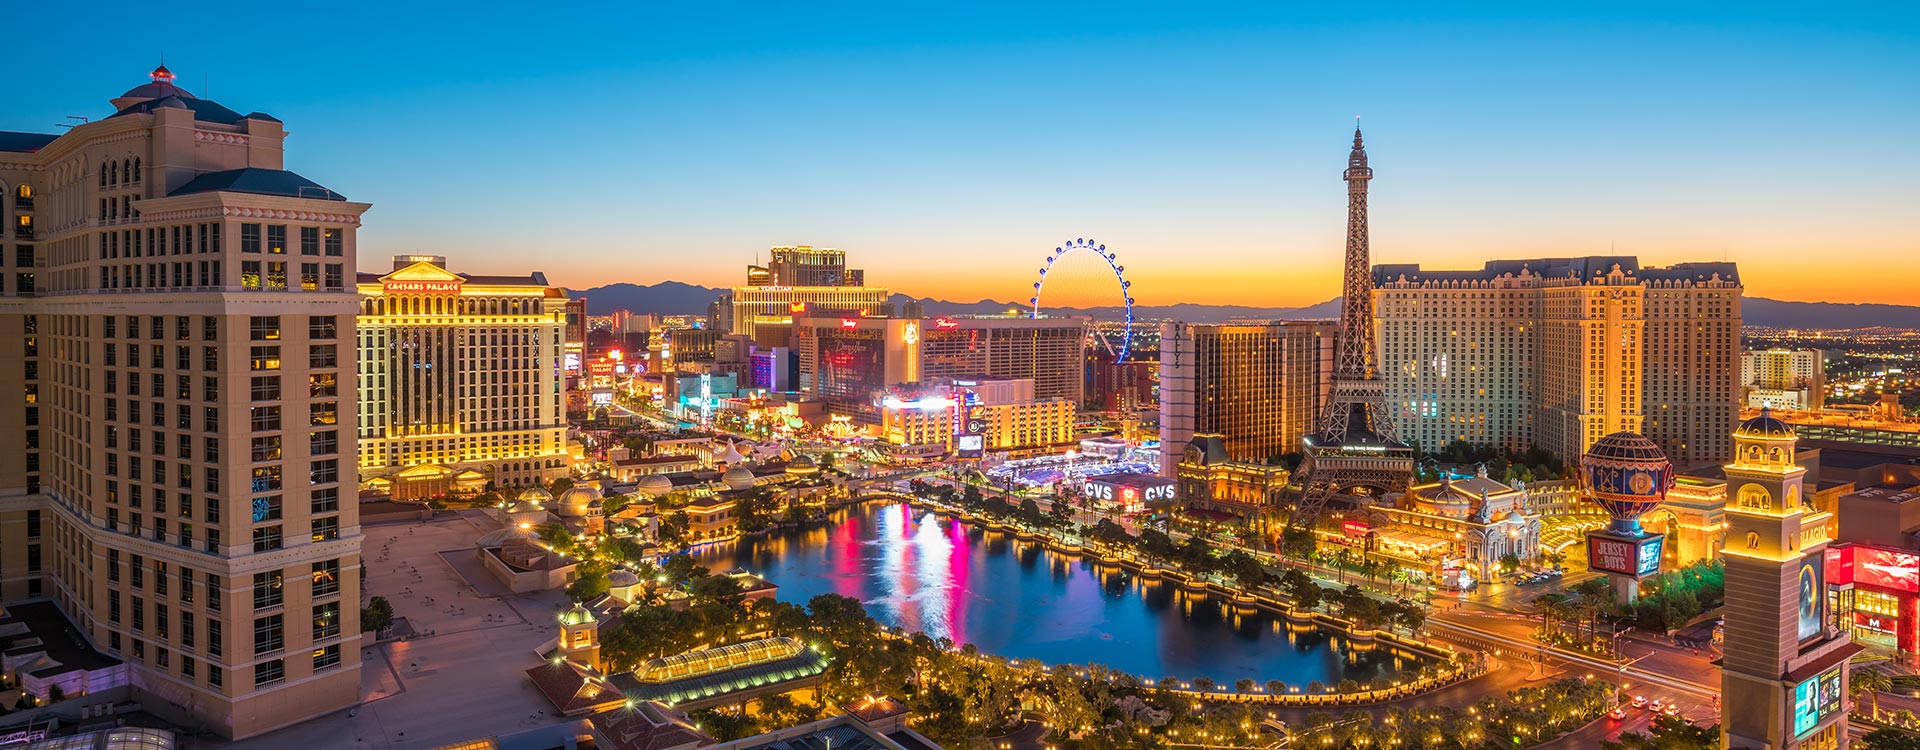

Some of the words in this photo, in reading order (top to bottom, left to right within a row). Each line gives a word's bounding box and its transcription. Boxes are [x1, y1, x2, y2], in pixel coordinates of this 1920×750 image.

[387, 283, 424, 291] CAESARS
[427, 283, 458, 291] PALACE
[1085, 482, 1113, 500] CVS
[1145, 485, 1175, 501] CVS
[1598, 542, 1628, 557] JERSEY
[1605, 556, 1626, 570] BOYS
[1869, 618, 1880, 628] M
